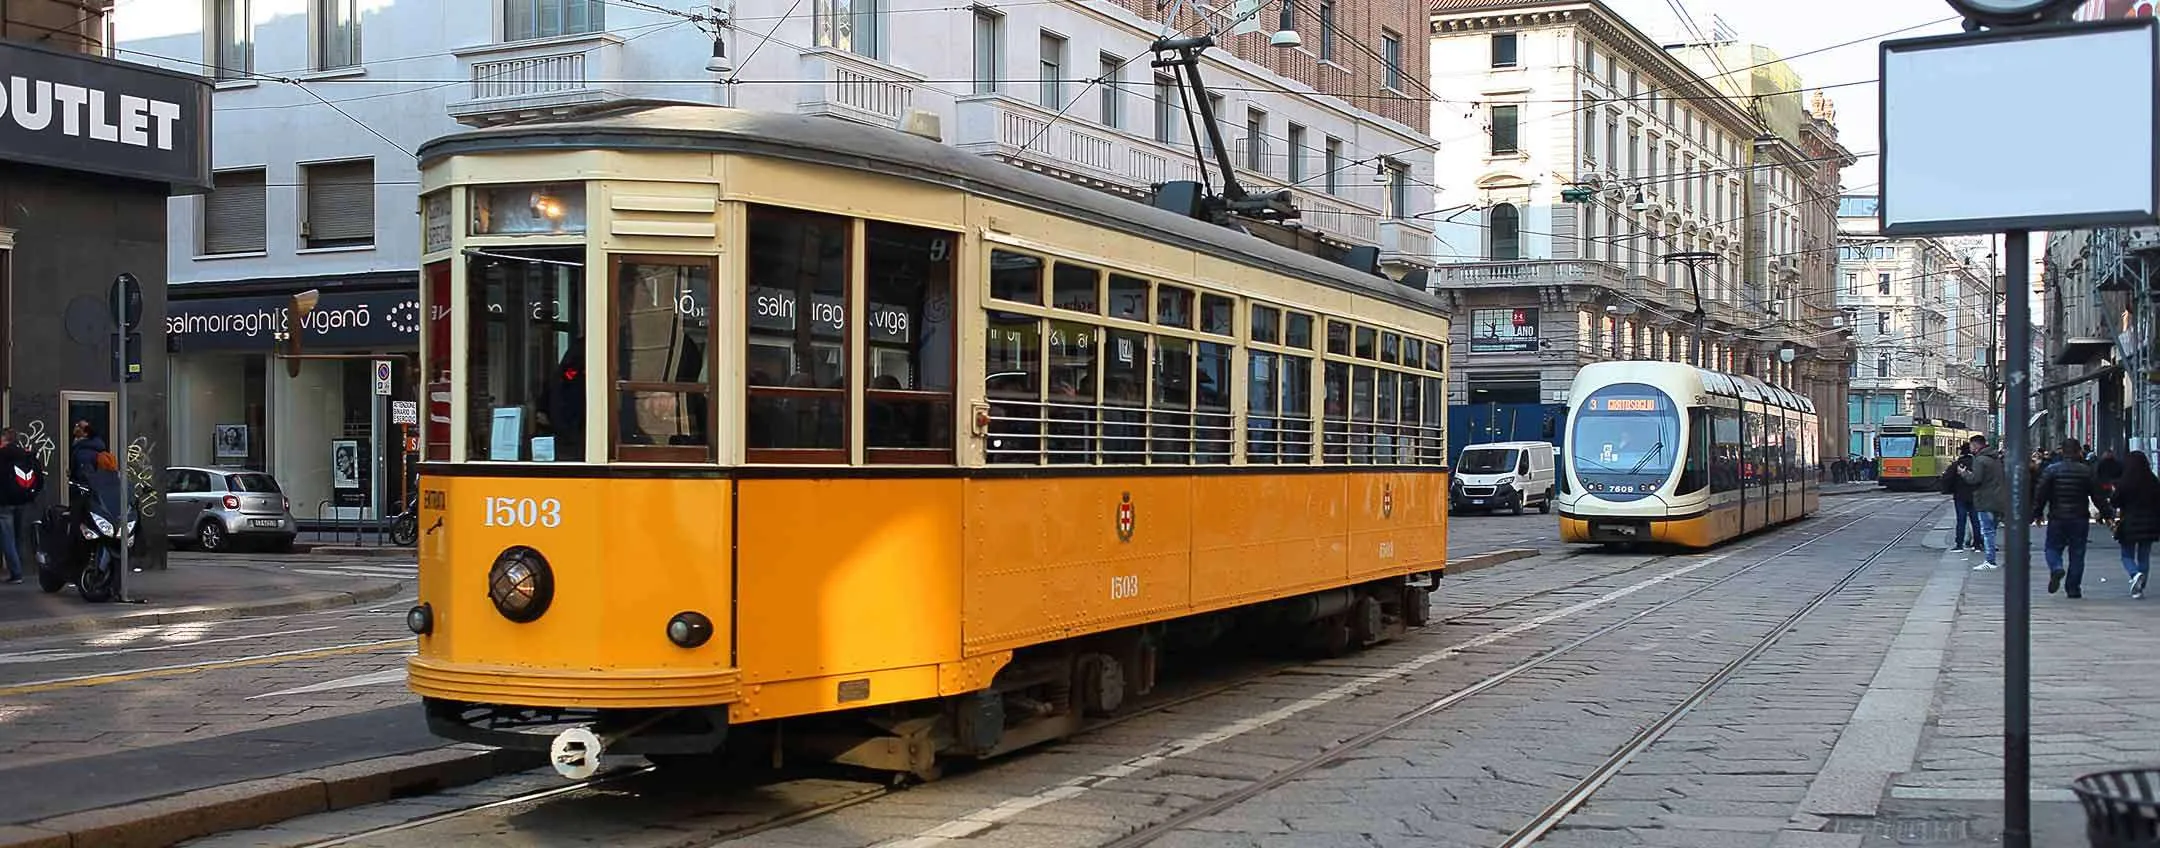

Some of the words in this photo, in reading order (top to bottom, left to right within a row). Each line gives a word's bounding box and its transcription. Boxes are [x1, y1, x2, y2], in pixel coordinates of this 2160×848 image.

[0, 75, 181, 151] UTLET
[167, 308, 276, 336] salmoiraghi
[484, 496, 561, 528] 1503
[1111, 575, 1138, 600] 1503
